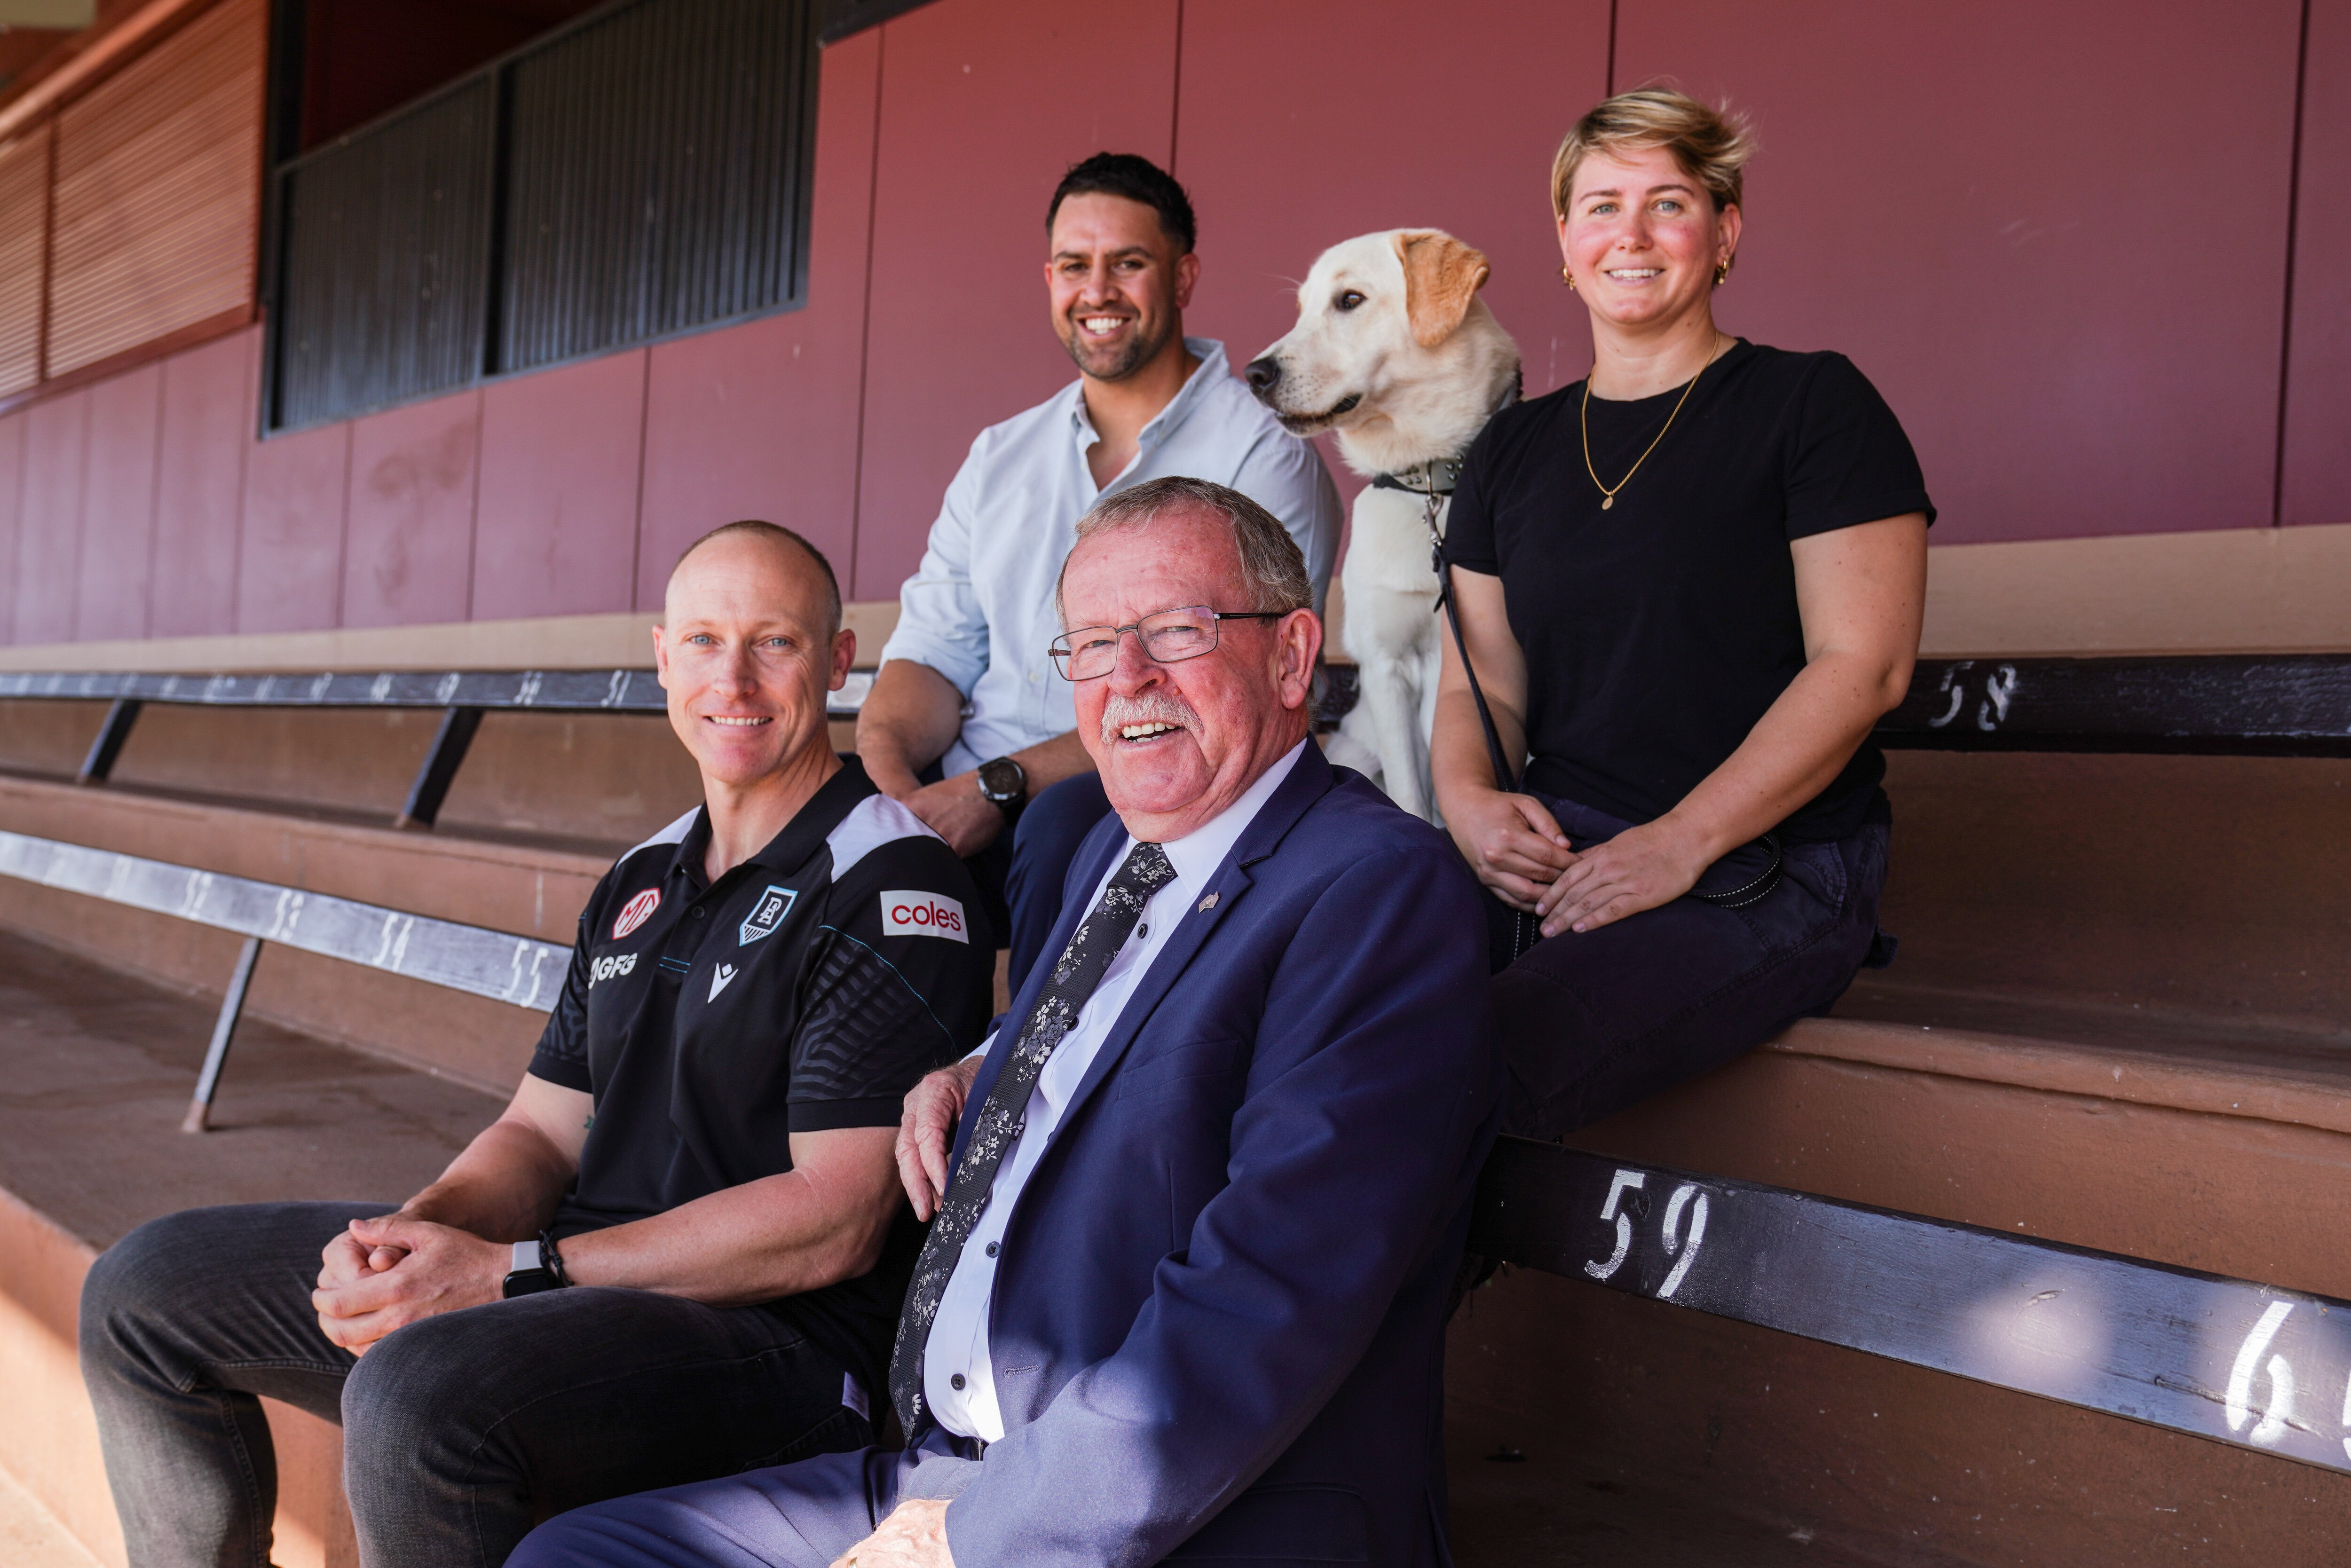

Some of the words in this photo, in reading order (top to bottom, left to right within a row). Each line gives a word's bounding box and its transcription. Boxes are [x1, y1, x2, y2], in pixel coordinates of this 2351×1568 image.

[1929, 661, 2017, 731] 58
[372, 912, 415, 972] 54
[618, 893, 655, 934] MG
[891, 900, 961, 931] coles
[501, 939, 549, 1008] 55
[1584, 1169, 1709, 1299] 59
